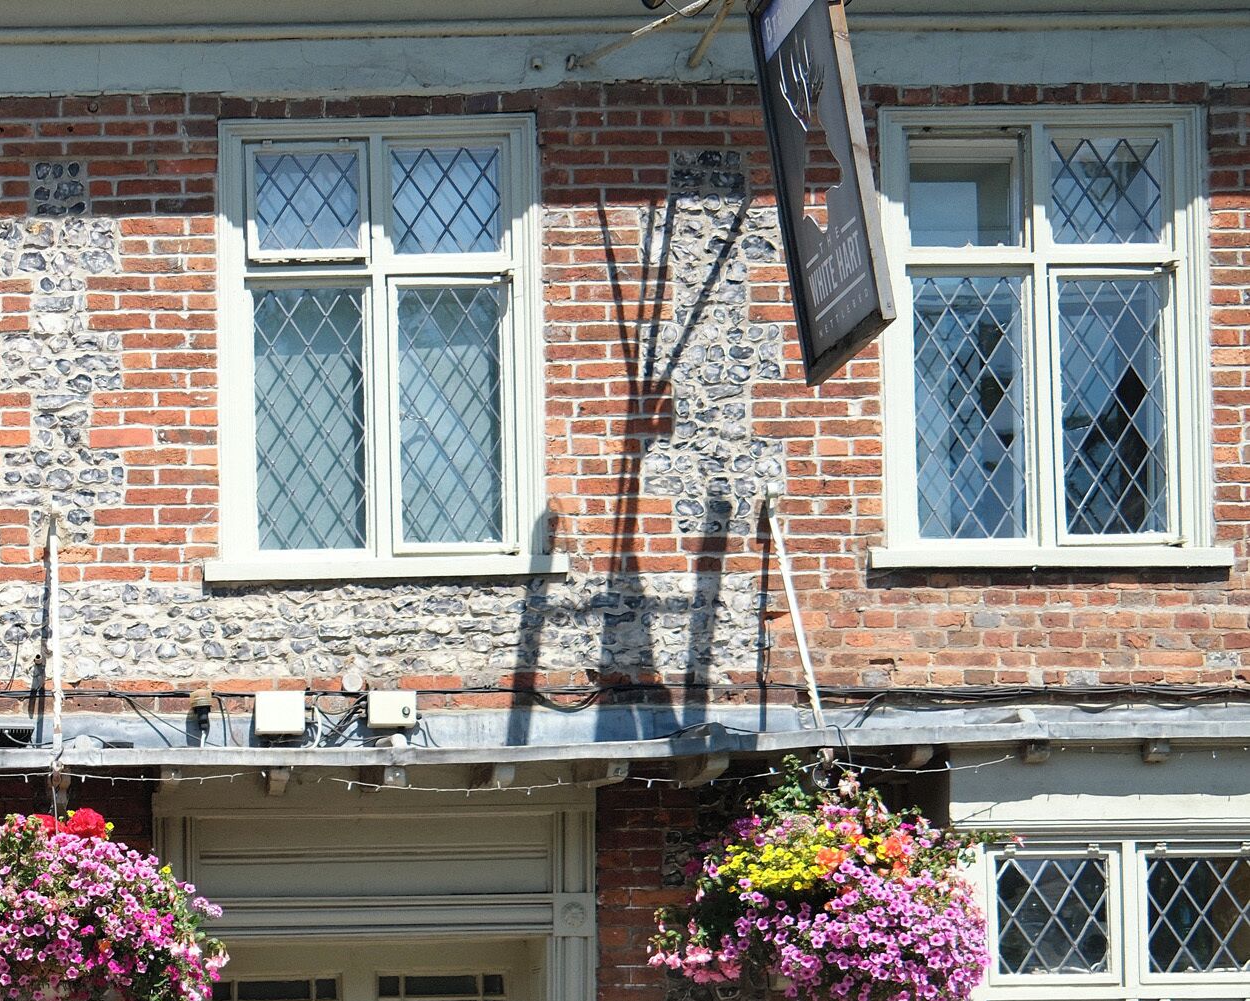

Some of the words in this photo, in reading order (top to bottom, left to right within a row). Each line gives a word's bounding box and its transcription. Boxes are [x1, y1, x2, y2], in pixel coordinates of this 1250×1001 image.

[818, 226, 840, 254] THE
[808, 254, 838, 308] WHITE
[835, 230, 862, 283] HART
